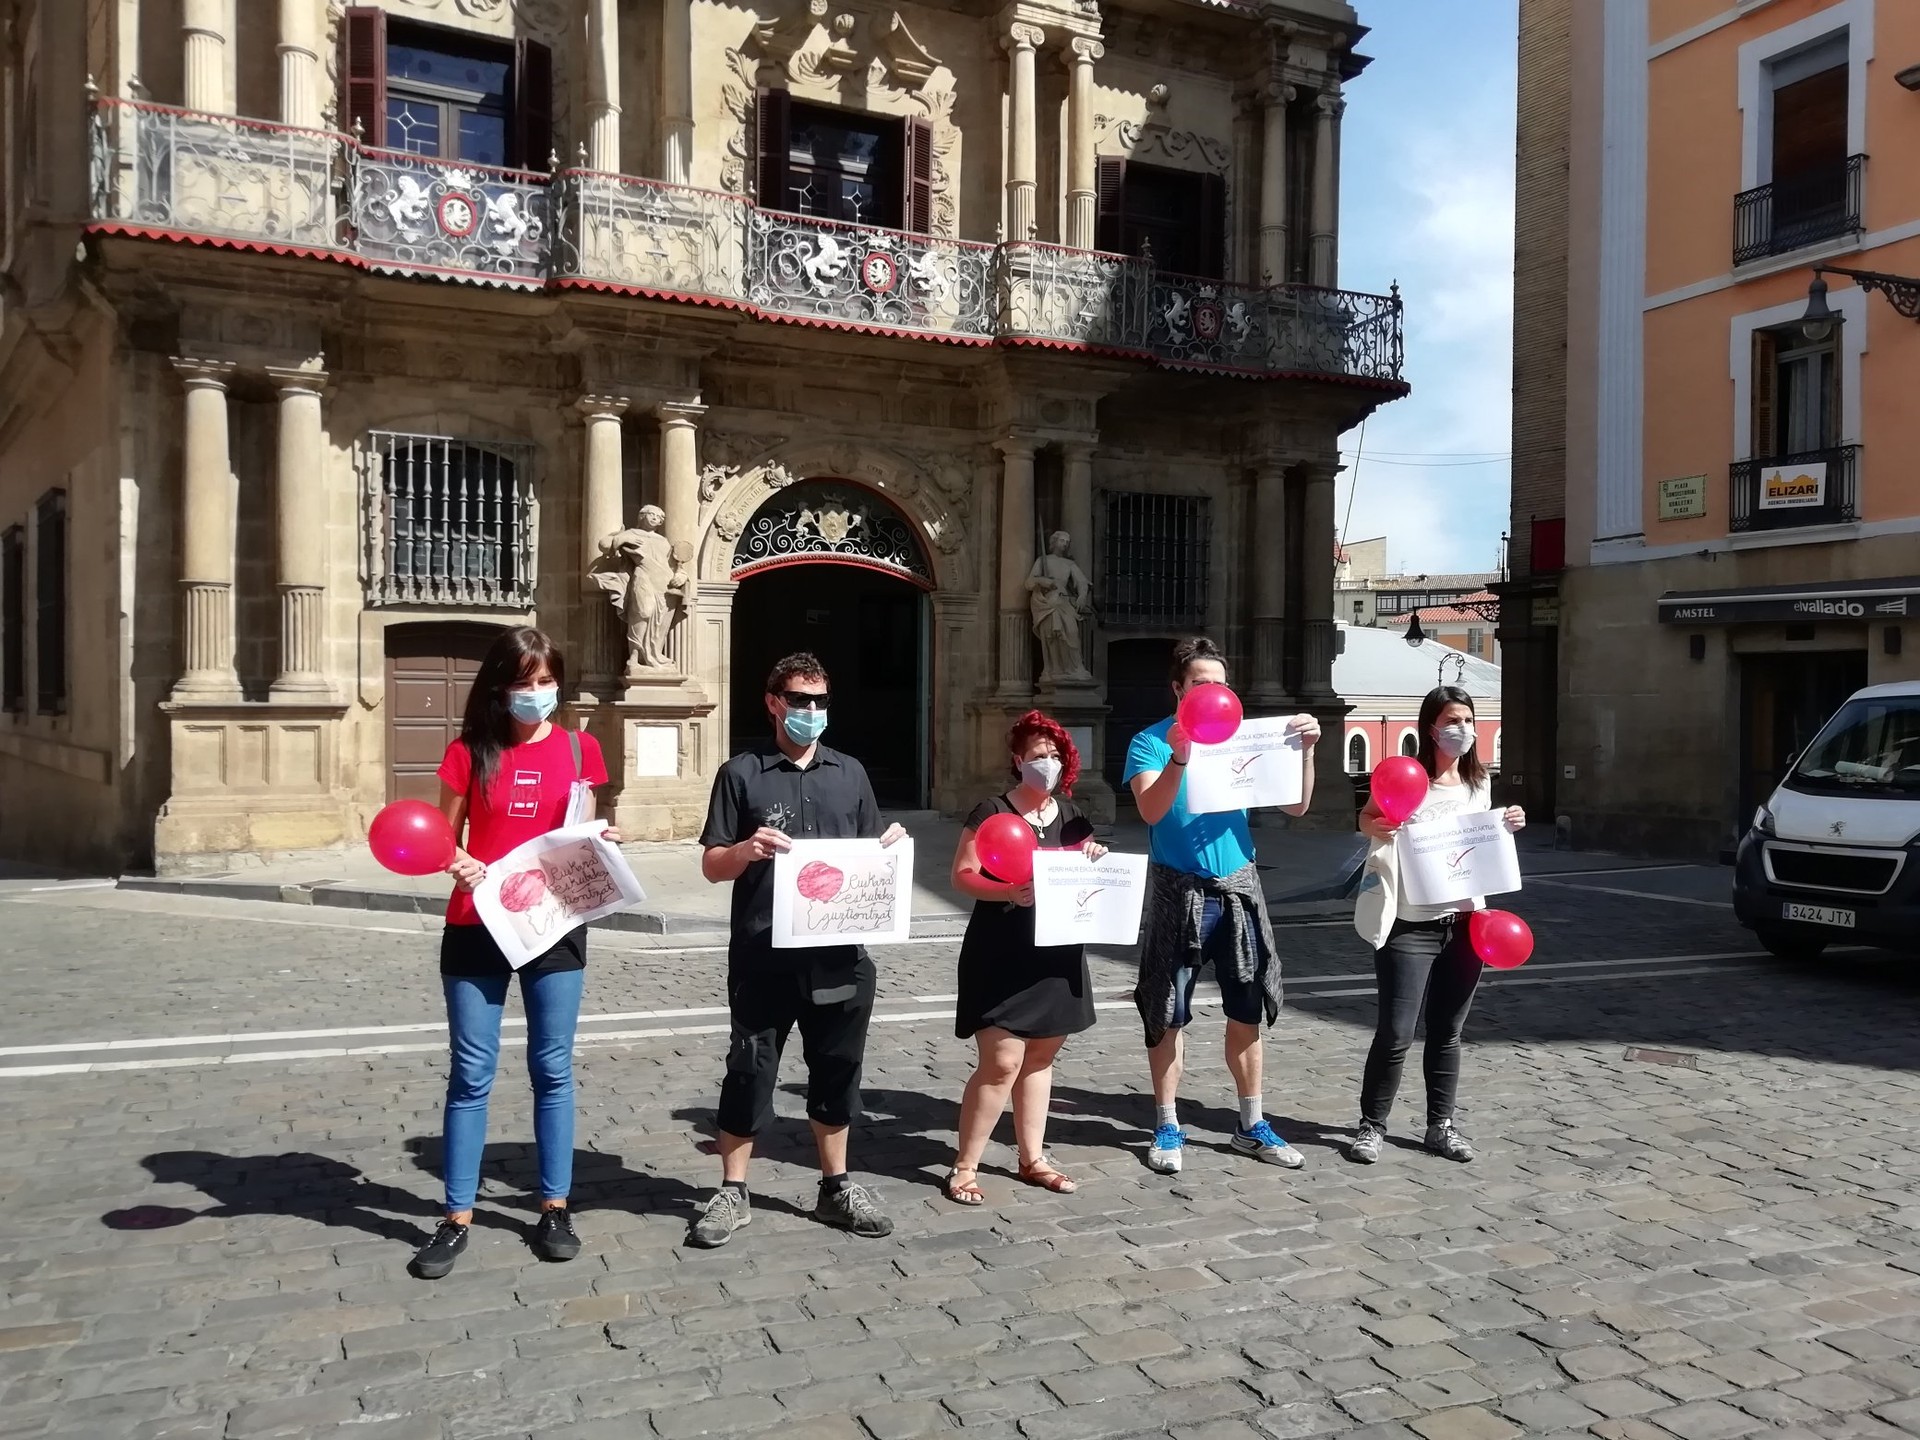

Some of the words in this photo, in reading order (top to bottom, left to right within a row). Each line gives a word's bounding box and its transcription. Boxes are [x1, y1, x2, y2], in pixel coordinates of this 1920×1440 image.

[1674, 482, 1688, 490] PLAZA
[1768, 484, 1819, 497] ELIZARI
[1665, 488, 1697, 498] CONSISTORIAL
[1675, 607, 1716, 619] AMSTEL
[1442, 829, 1462, 838] ESKOLA
[1462, 823, 1497, 835] KONTAKTUA
[1097, 866, 1131, 876] KONTAKTUA
[1792, 905, 1823, 922] 3424
[1828, 910, 1852, 926] JTX
